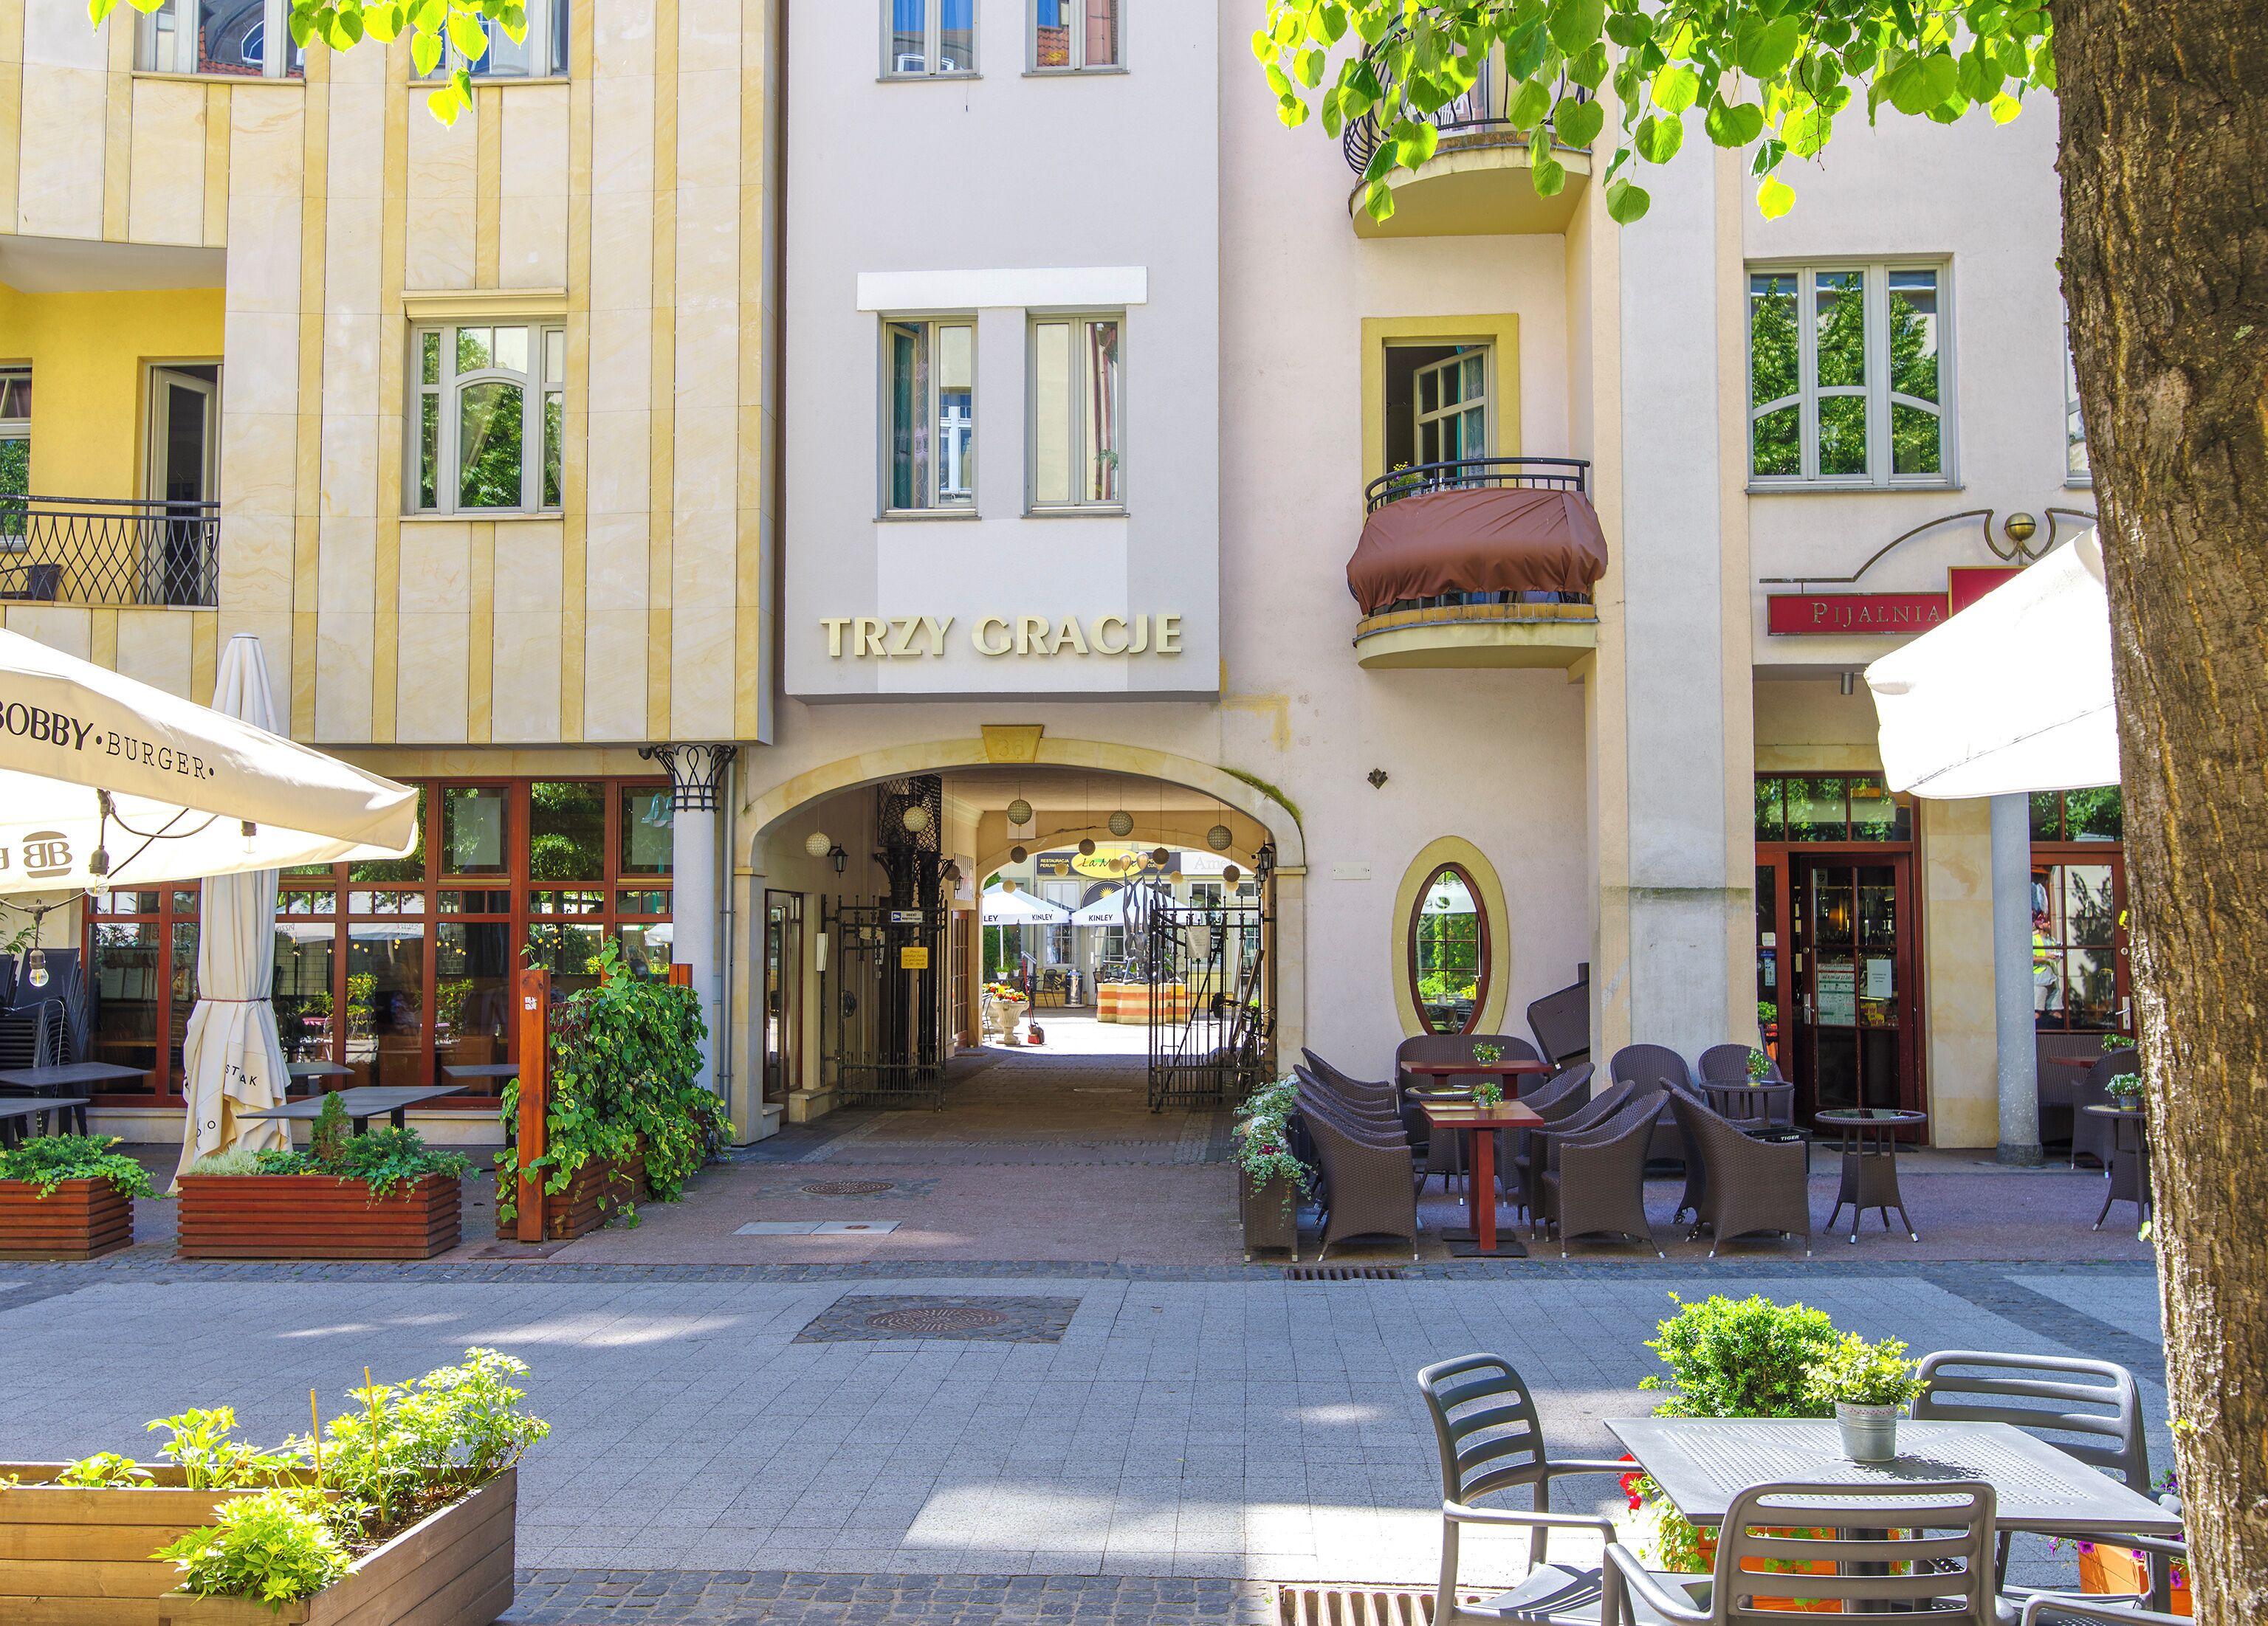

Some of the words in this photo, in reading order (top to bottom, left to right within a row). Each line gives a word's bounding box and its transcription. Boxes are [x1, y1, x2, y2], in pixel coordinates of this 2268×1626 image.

[819, 616, 955, 657] TRZY
[970, 613, 1183, 655] GRACJE
[1811, 602, 1943, 627] PIJALNIA
[0, 701, 94, 751] OBBY
